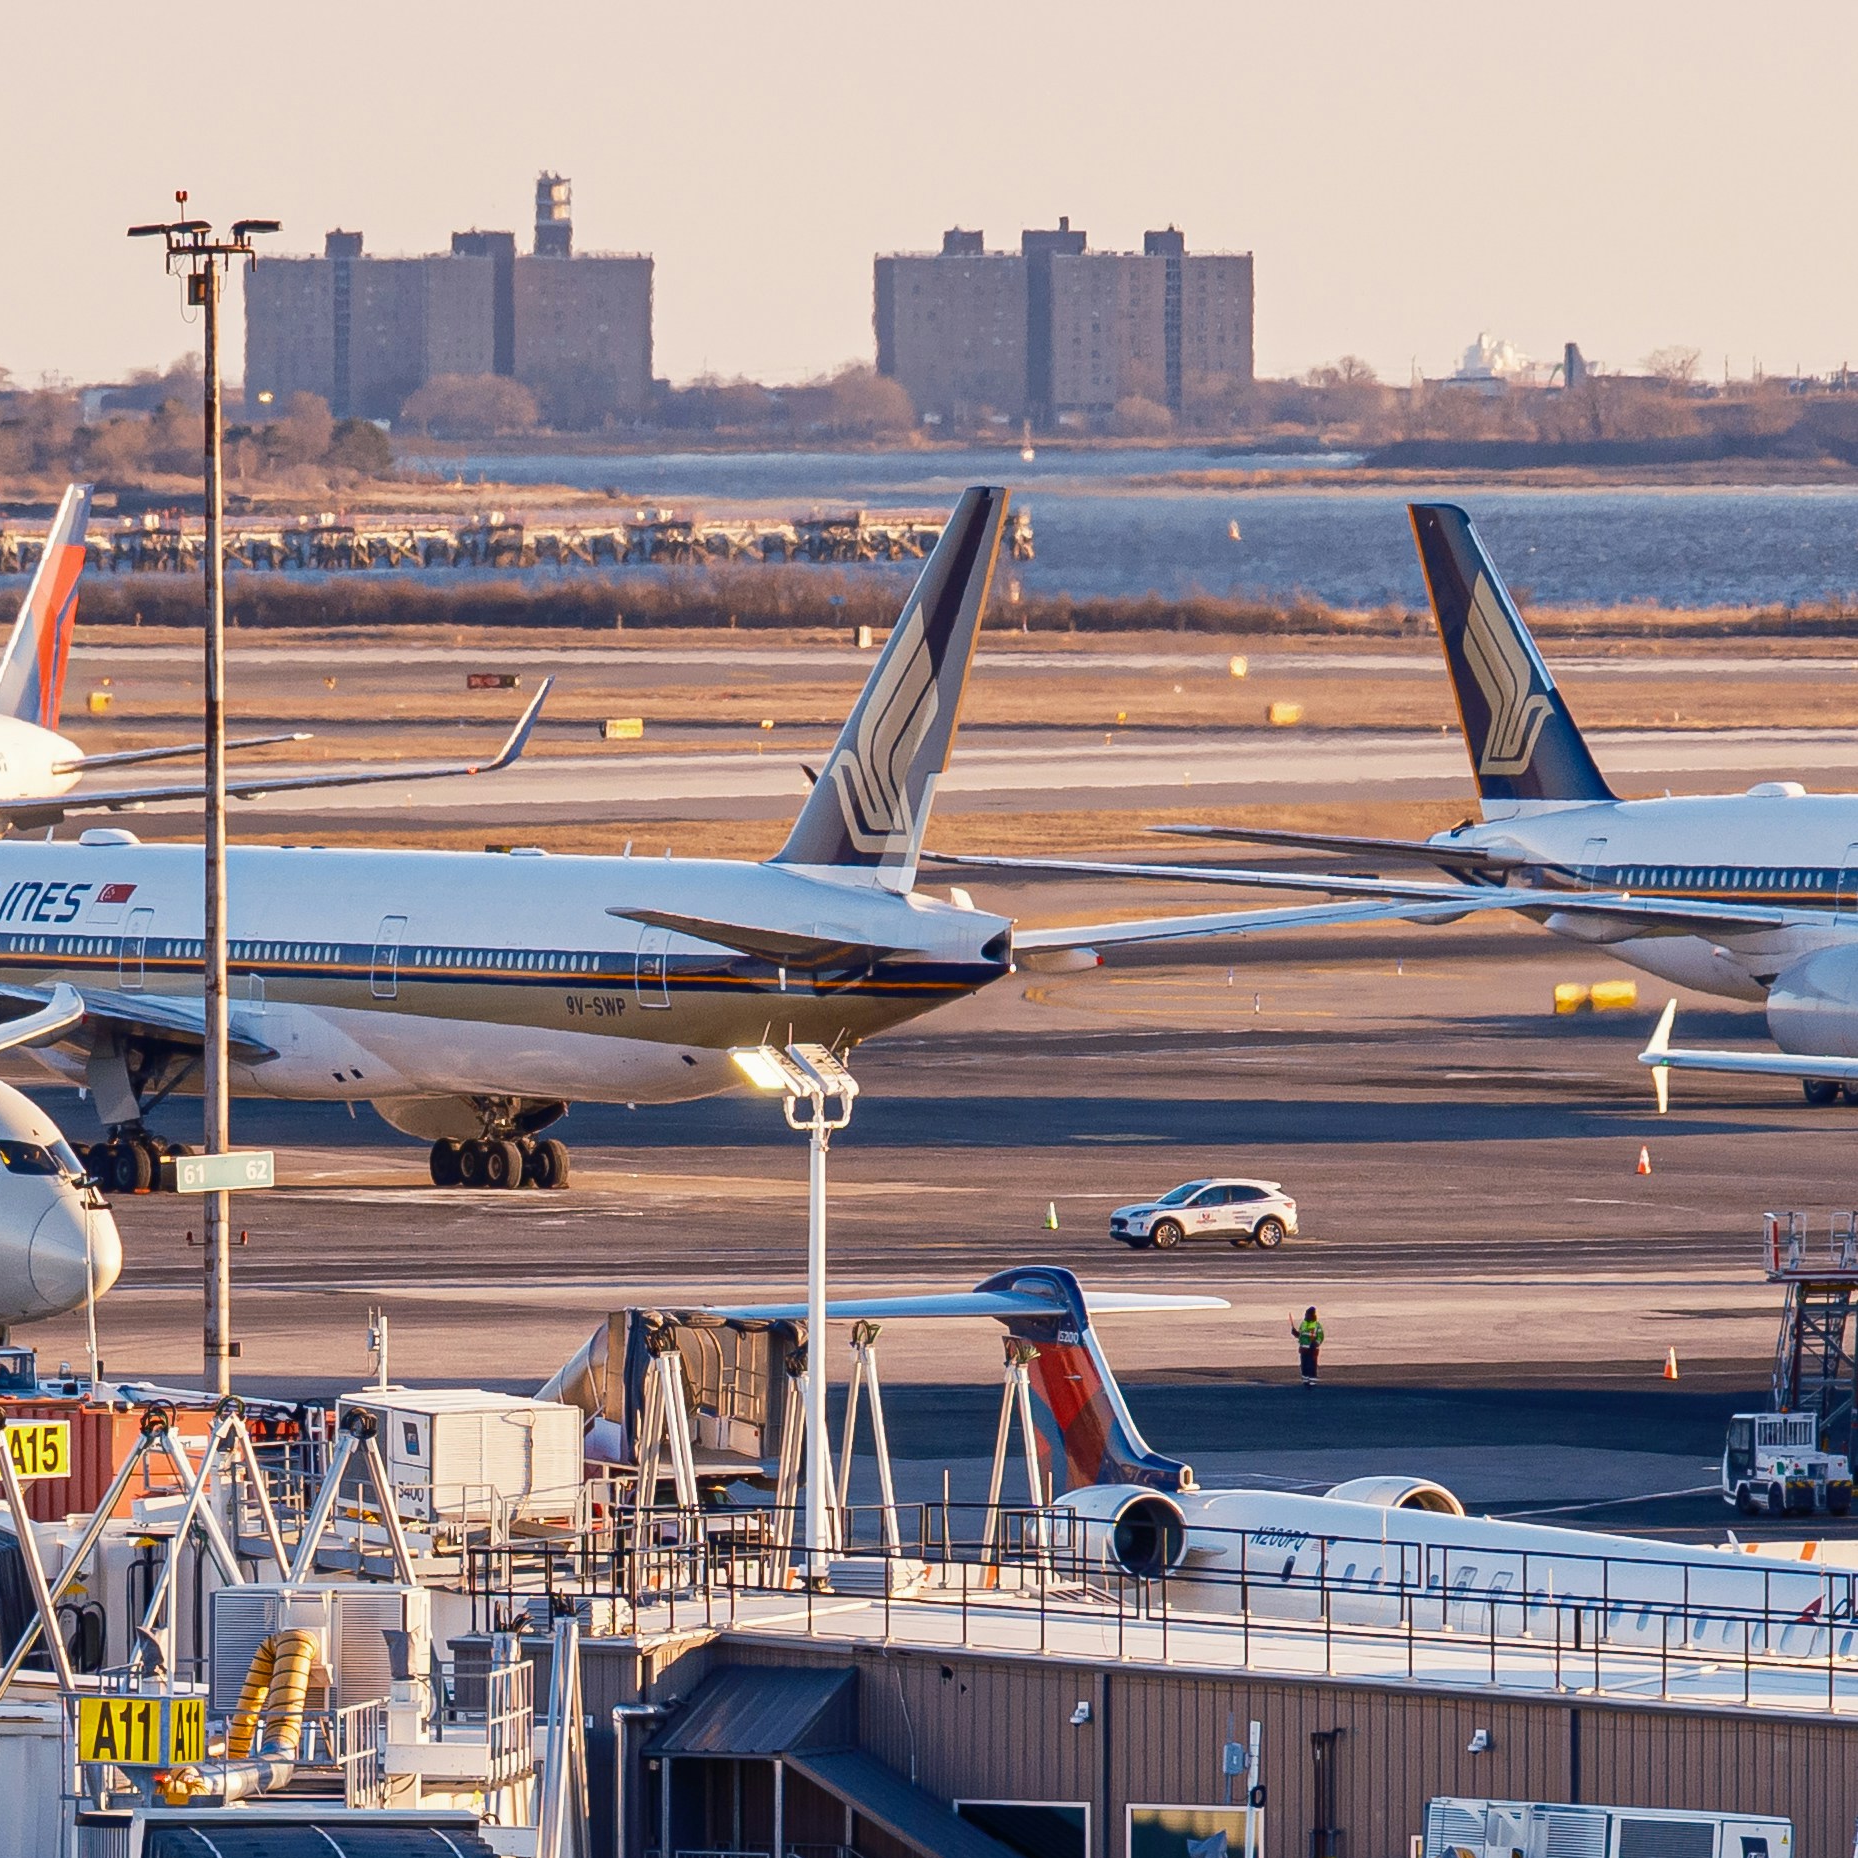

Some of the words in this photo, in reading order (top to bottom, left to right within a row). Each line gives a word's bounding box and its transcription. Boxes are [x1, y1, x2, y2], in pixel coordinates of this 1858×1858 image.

[566, 995, 626, 1017] 9V-SWP
[183, 1163, 204, 1185] 61
[245, 1159, 268, 1181] 62
[93, 1700, 151, 1763] A11
[175, 1701, 200, 1763] A11
